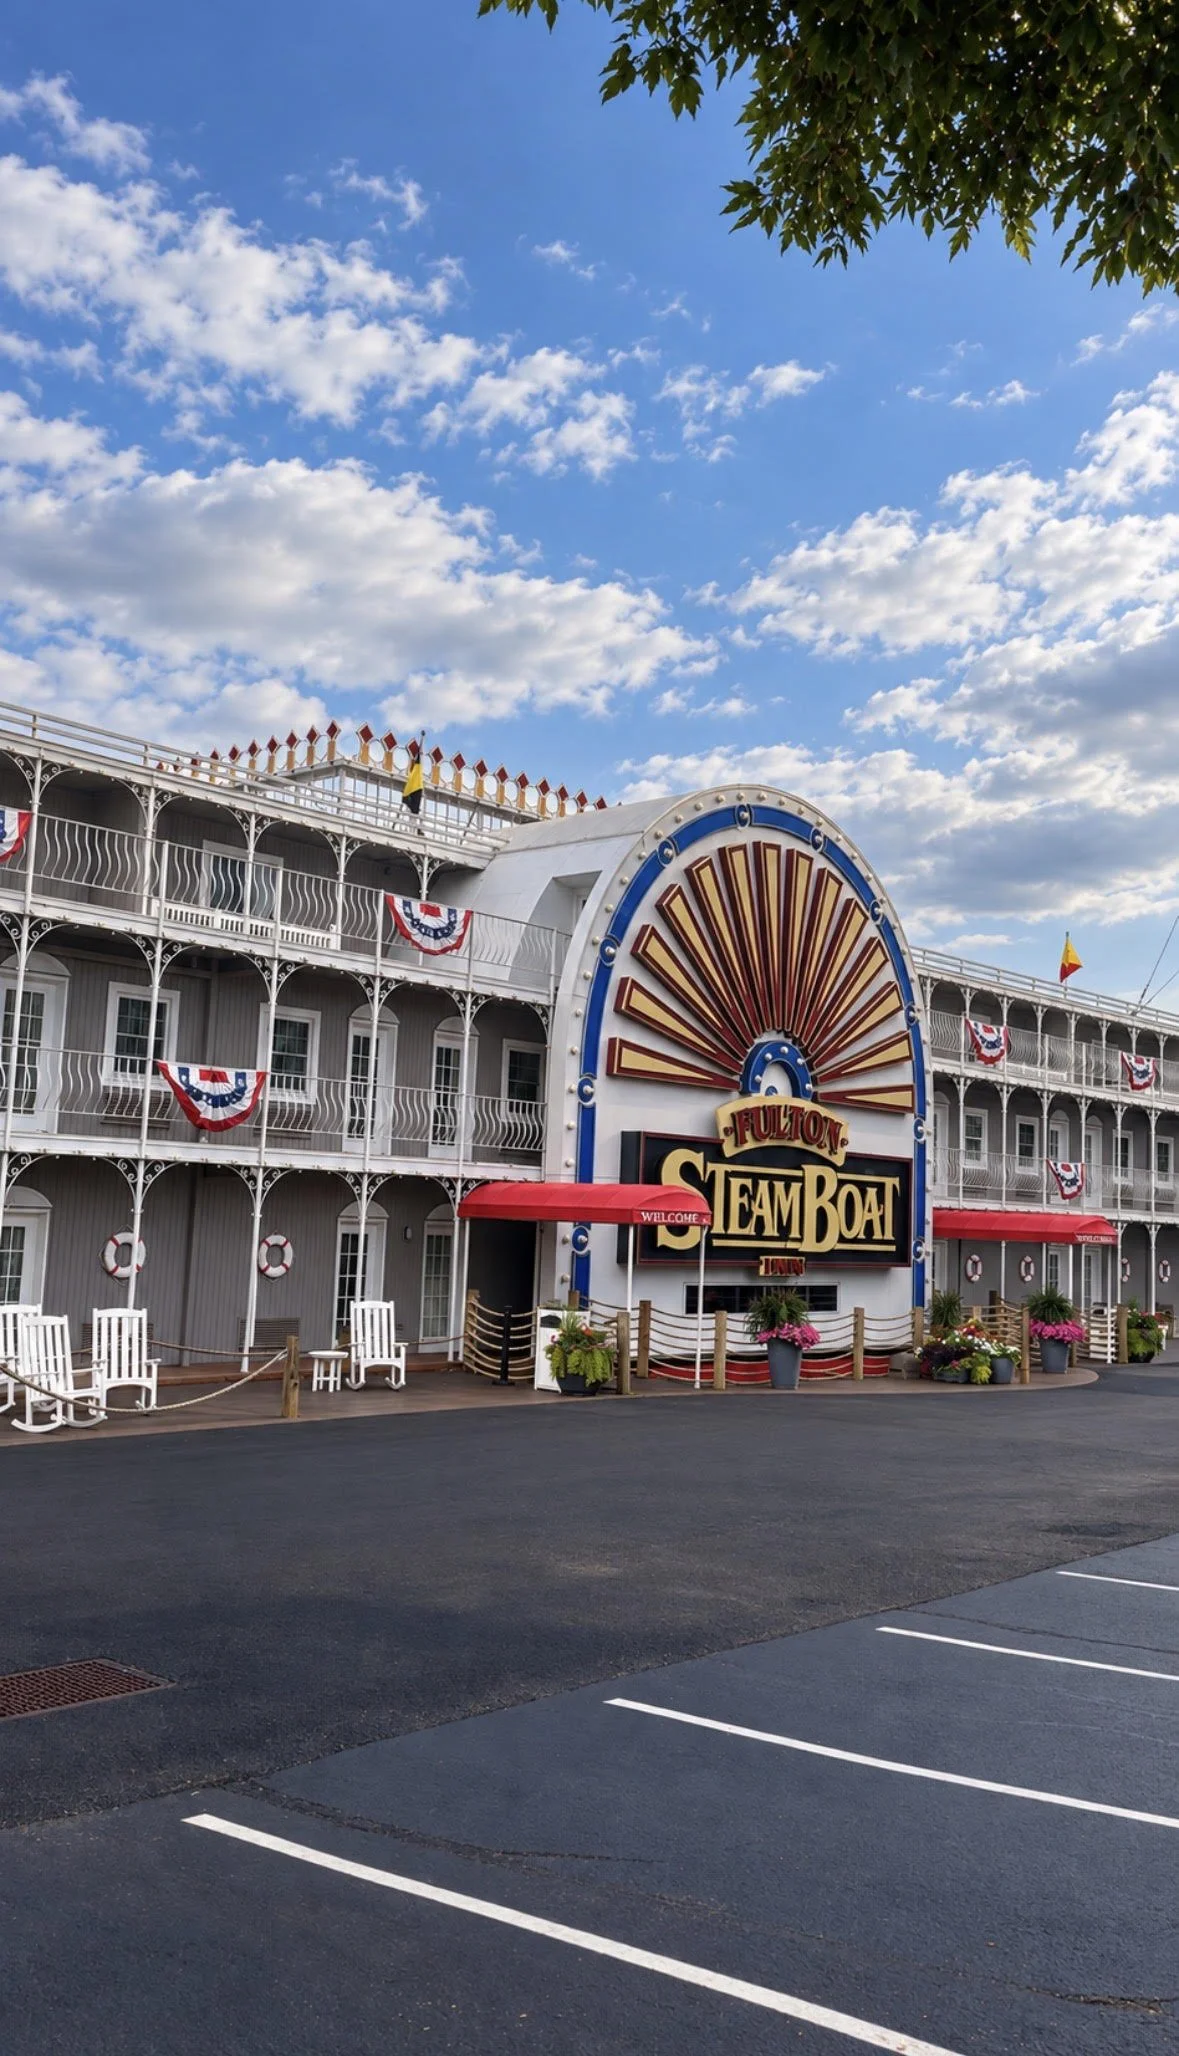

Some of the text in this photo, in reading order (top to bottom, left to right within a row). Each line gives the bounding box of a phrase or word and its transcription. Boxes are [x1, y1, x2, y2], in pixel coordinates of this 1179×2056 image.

[732, 1104, 844, 1156] FULTON
[641, 1211, 699, 1224] WELCOME
[763, 1257, 805, 1276] INN
